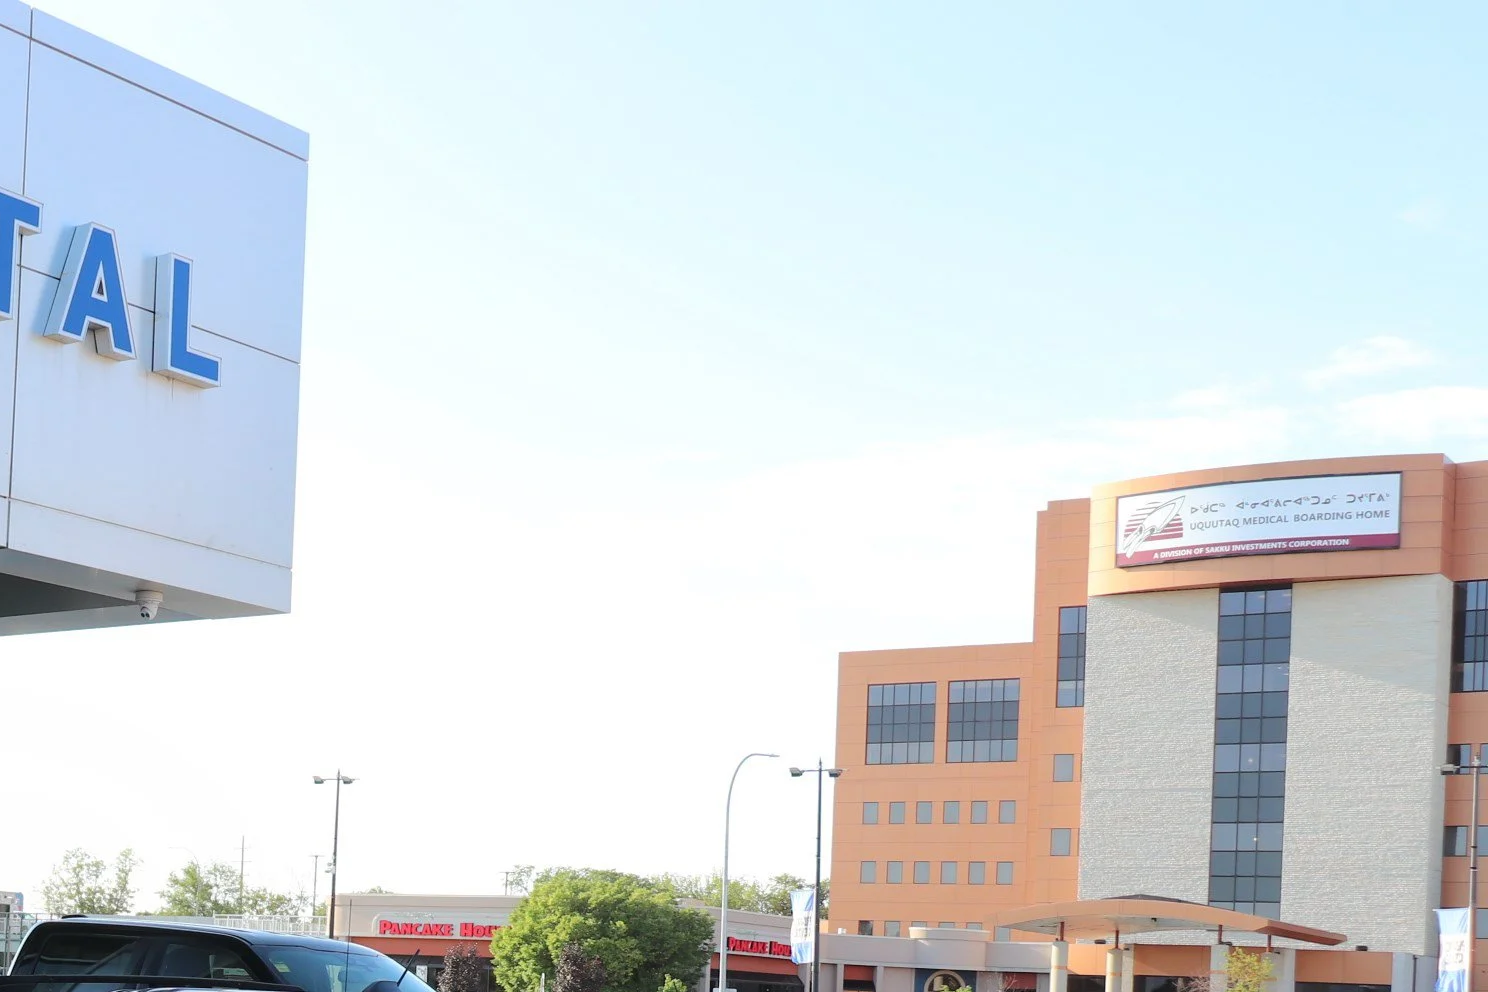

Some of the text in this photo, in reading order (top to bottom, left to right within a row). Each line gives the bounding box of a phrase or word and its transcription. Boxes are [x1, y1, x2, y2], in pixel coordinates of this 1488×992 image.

[1190, 509, 1390, 531] UQUUTAQ MEDICAL BOARDING HOME
[1159, 547, 1192, 557] DIVISION
[1194, 547, 1203, 555] OF
[1205, 544, 1230, 554] SAKKU
[1231, 541, 1287, 552] INVESTMENTS
[1288, 538, 1350, 548] CORPORATION
